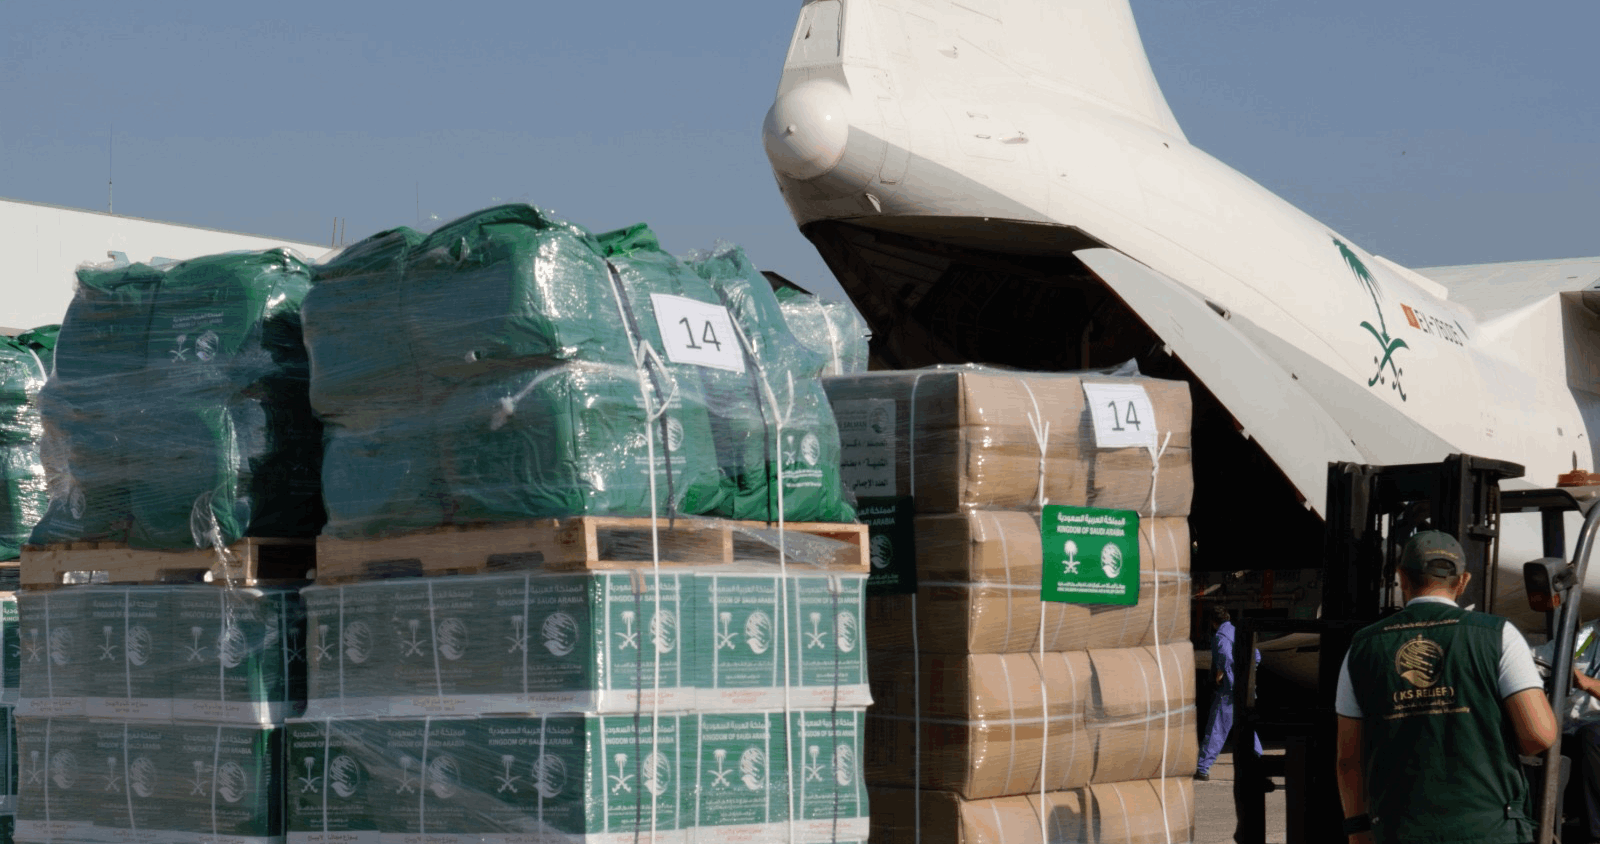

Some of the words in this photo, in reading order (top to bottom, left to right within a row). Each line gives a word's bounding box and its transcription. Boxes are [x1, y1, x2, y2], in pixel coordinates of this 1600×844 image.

[679, 317, 722, 352] 14
[1108, 400, 1141, 431] 14
[873, 517, 896, 526] ARABIA
[1057, 525, 1081, 534] KINGDOM
[1082, 526, 1089, 534] OF
[1090, 527, 1105, 536] SAUDI
[1105, 528, 1125, 537] ARABIA
[488, 738, 518, 746] KINGDOM
[548, 738, 574, 746] ARABIA
